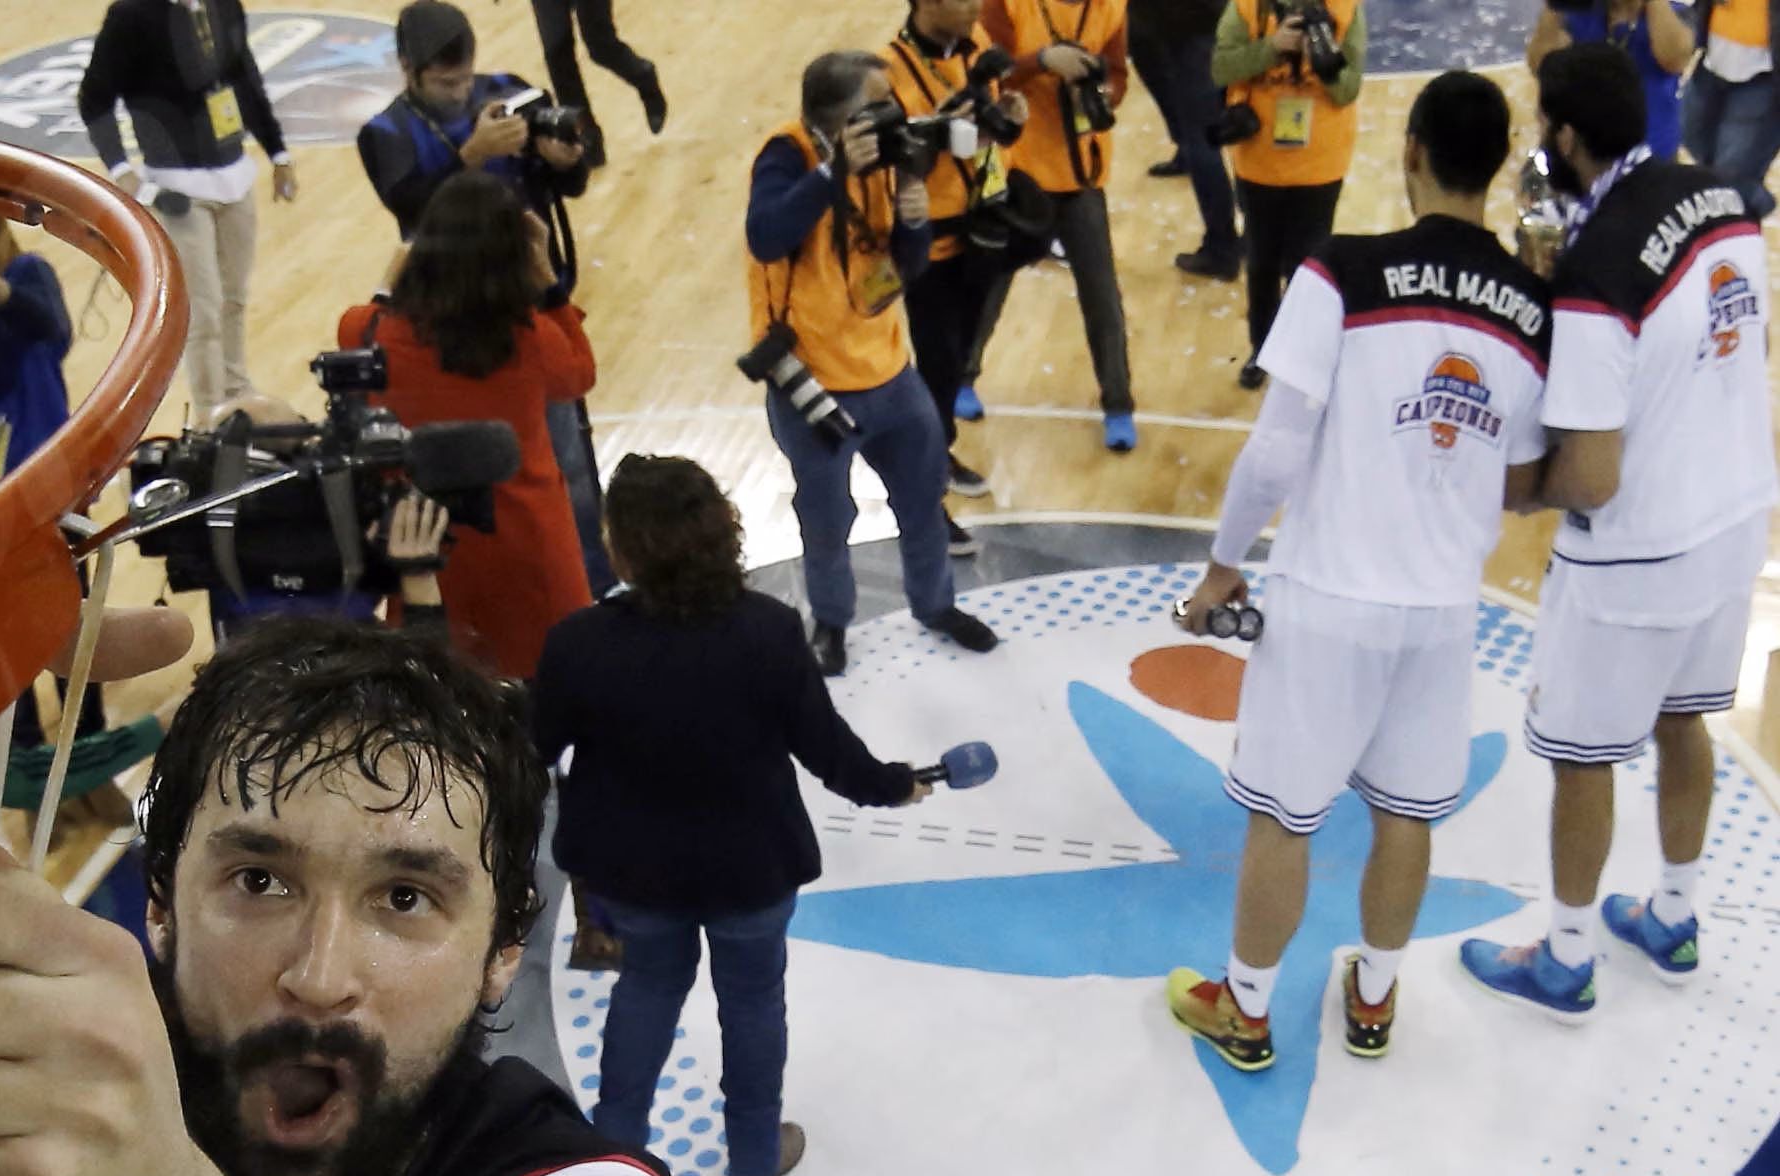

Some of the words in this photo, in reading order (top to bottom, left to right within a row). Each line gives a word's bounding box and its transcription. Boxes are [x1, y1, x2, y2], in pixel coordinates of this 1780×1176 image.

[1637, 214, 1691, 276] REAL
[1383, 263, 1452, 299] REAL
[1456, 270, 1545, 337] MADRID
